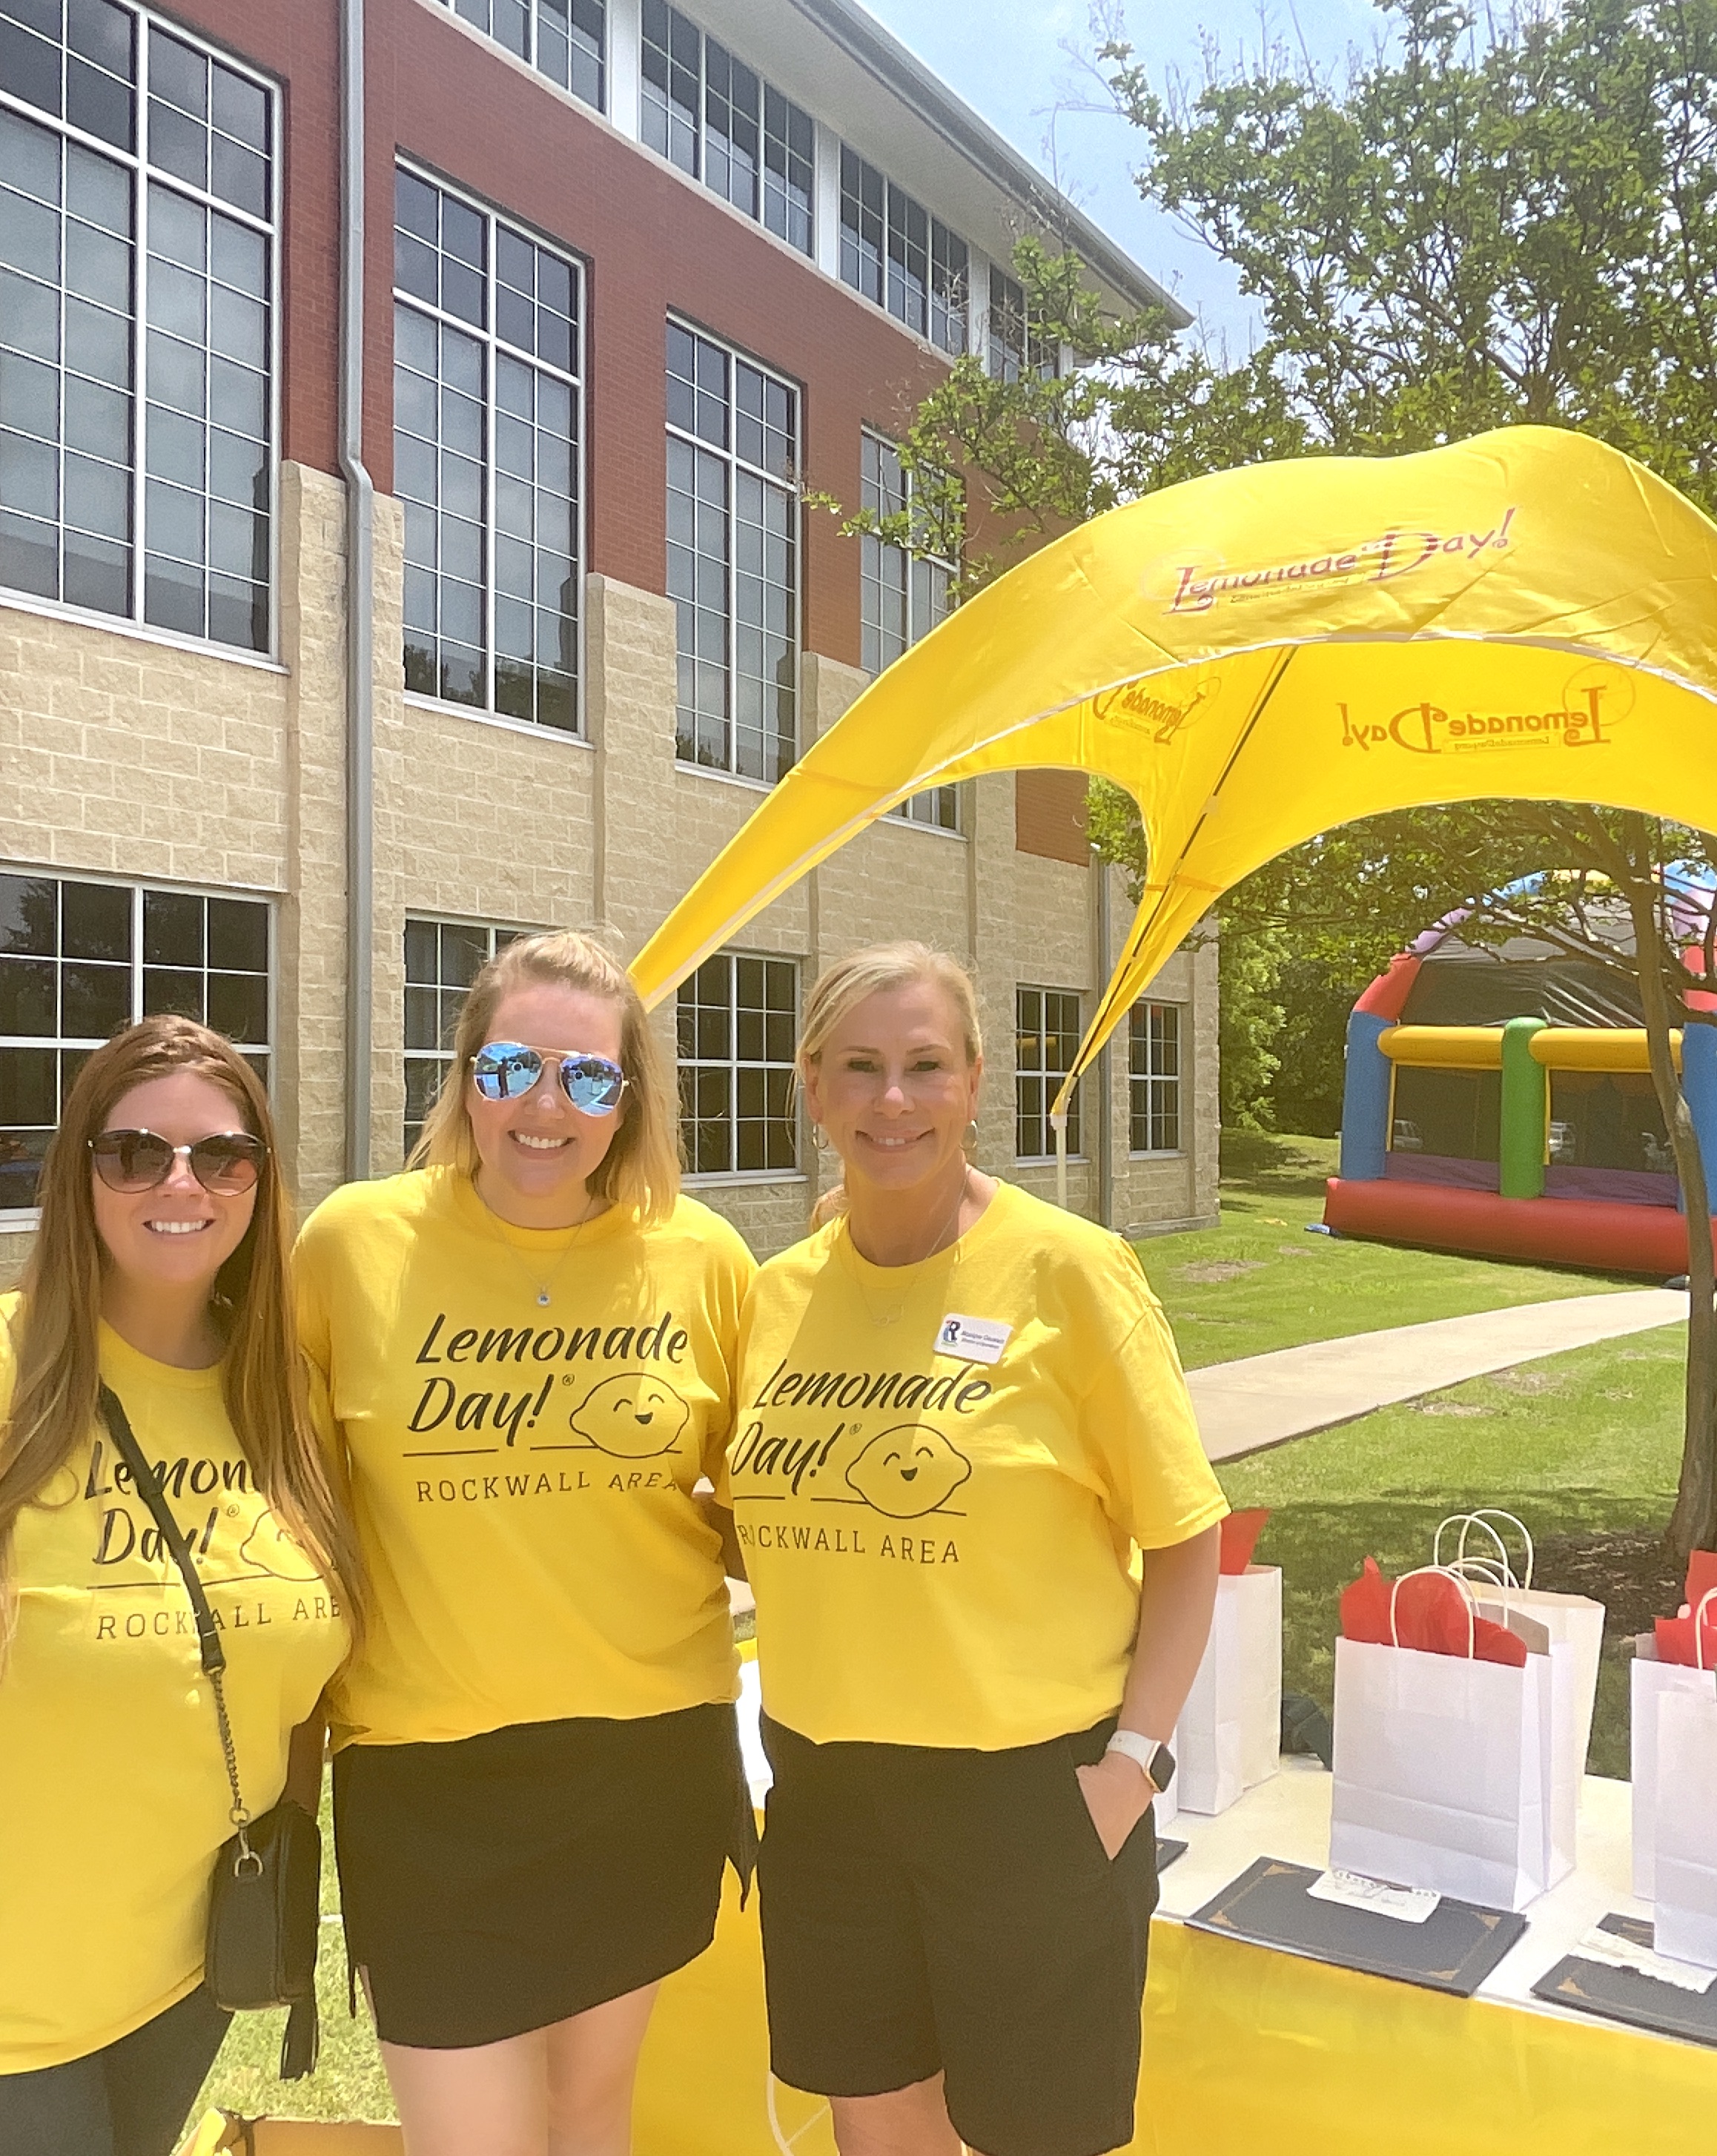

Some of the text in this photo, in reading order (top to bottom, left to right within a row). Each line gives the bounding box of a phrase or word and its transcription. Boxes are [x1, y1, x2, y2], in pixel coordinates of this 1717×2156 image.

[1162, 508, 1516, 615] Lemonade Day!
[415, 1311, 689, 1364] Lemonade
[753, 1358, 992, 1414] Lemonade
[417, 1471, 678, 1503] ROCKWALL AREA
[736, 1524, 960, 1565] RCKWALL AREA
[96, 1601, 272, 1640] ROCKALL
